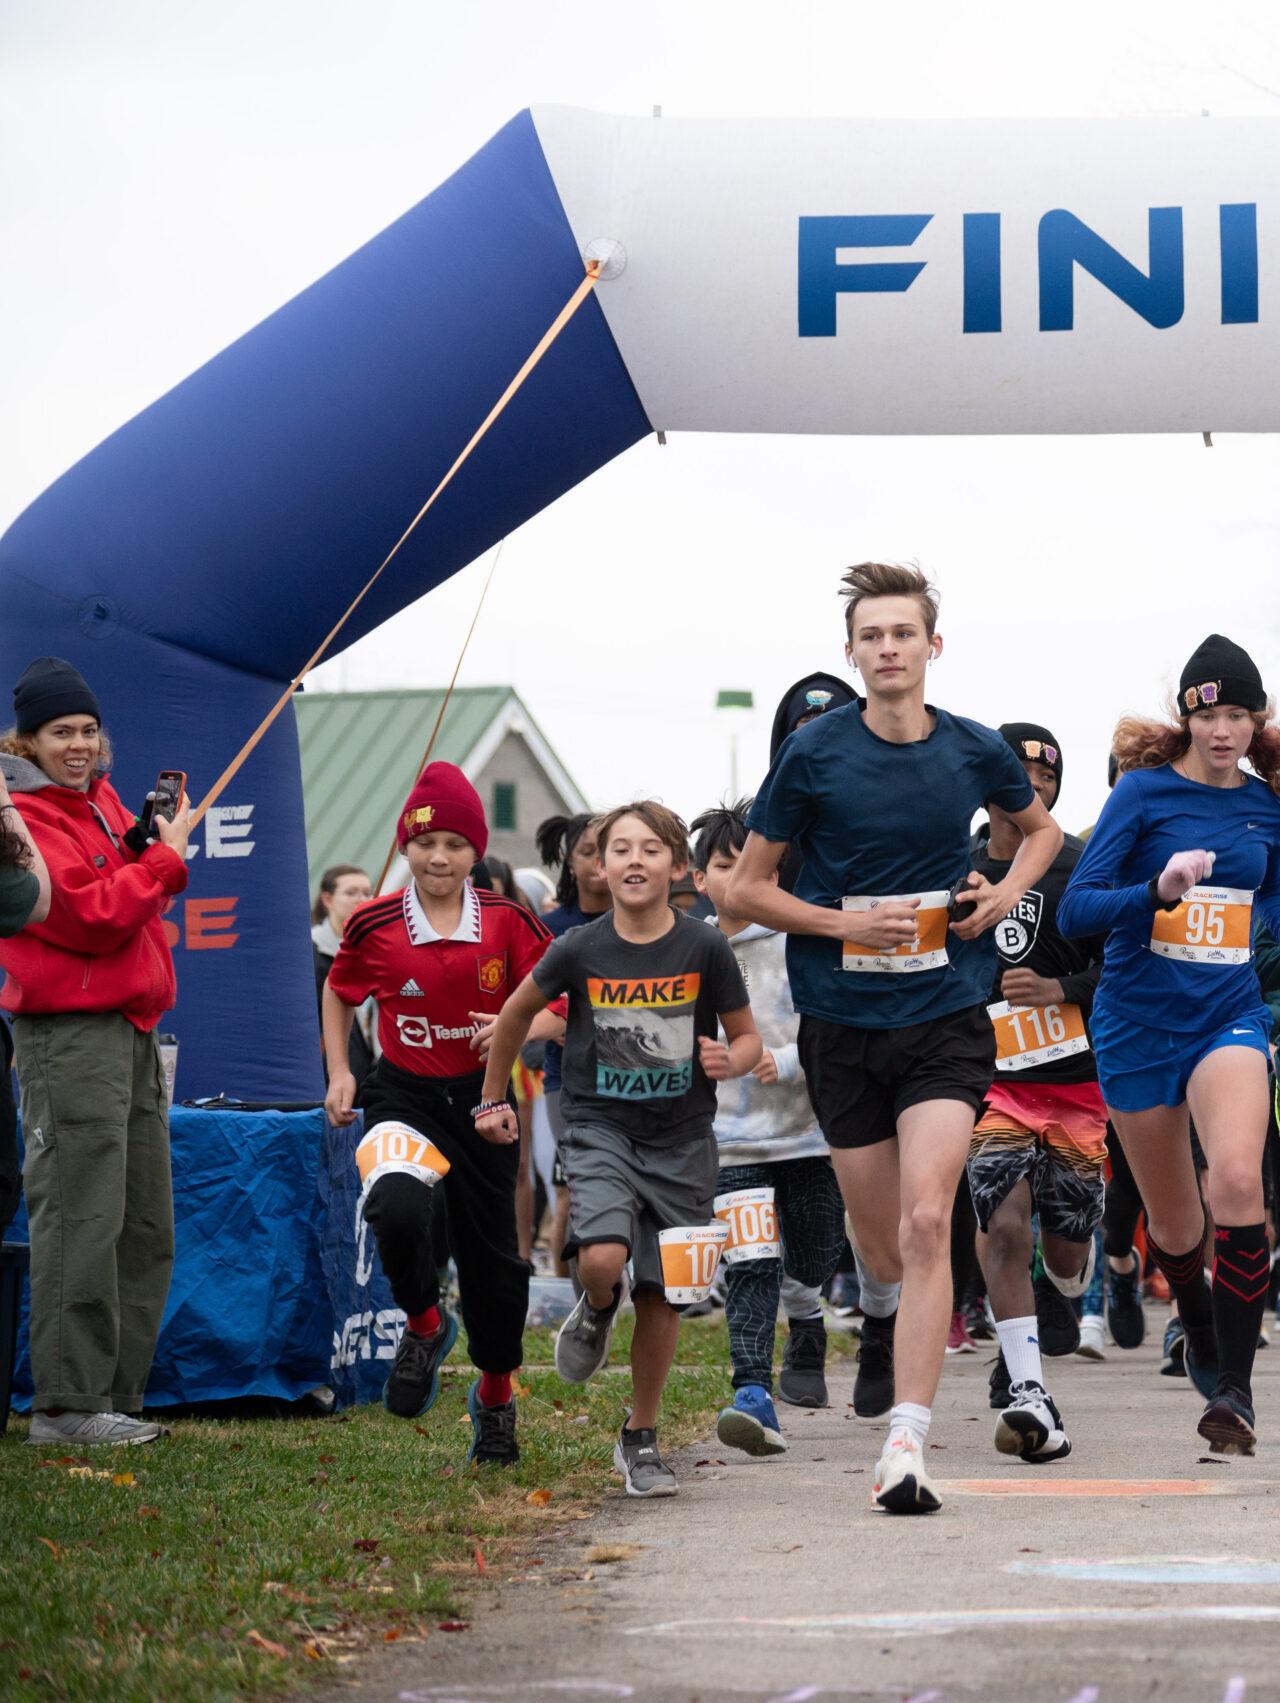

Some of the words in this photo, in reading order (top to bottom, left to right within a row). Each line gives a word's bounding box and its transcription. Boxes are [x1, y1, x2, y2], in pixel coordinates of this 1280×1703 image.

[1004, 928, 1020, 947] B
[1185, 903, 1225, 945] 95
[600, 979, 686, 1004] MAKE
[1007, 1005, 1066, 1051] 116
[604, 1067, 689, 1095] WAVES
[372, 1133, 427, 1165] 107
[726, 1203, 775, 1246] 106
